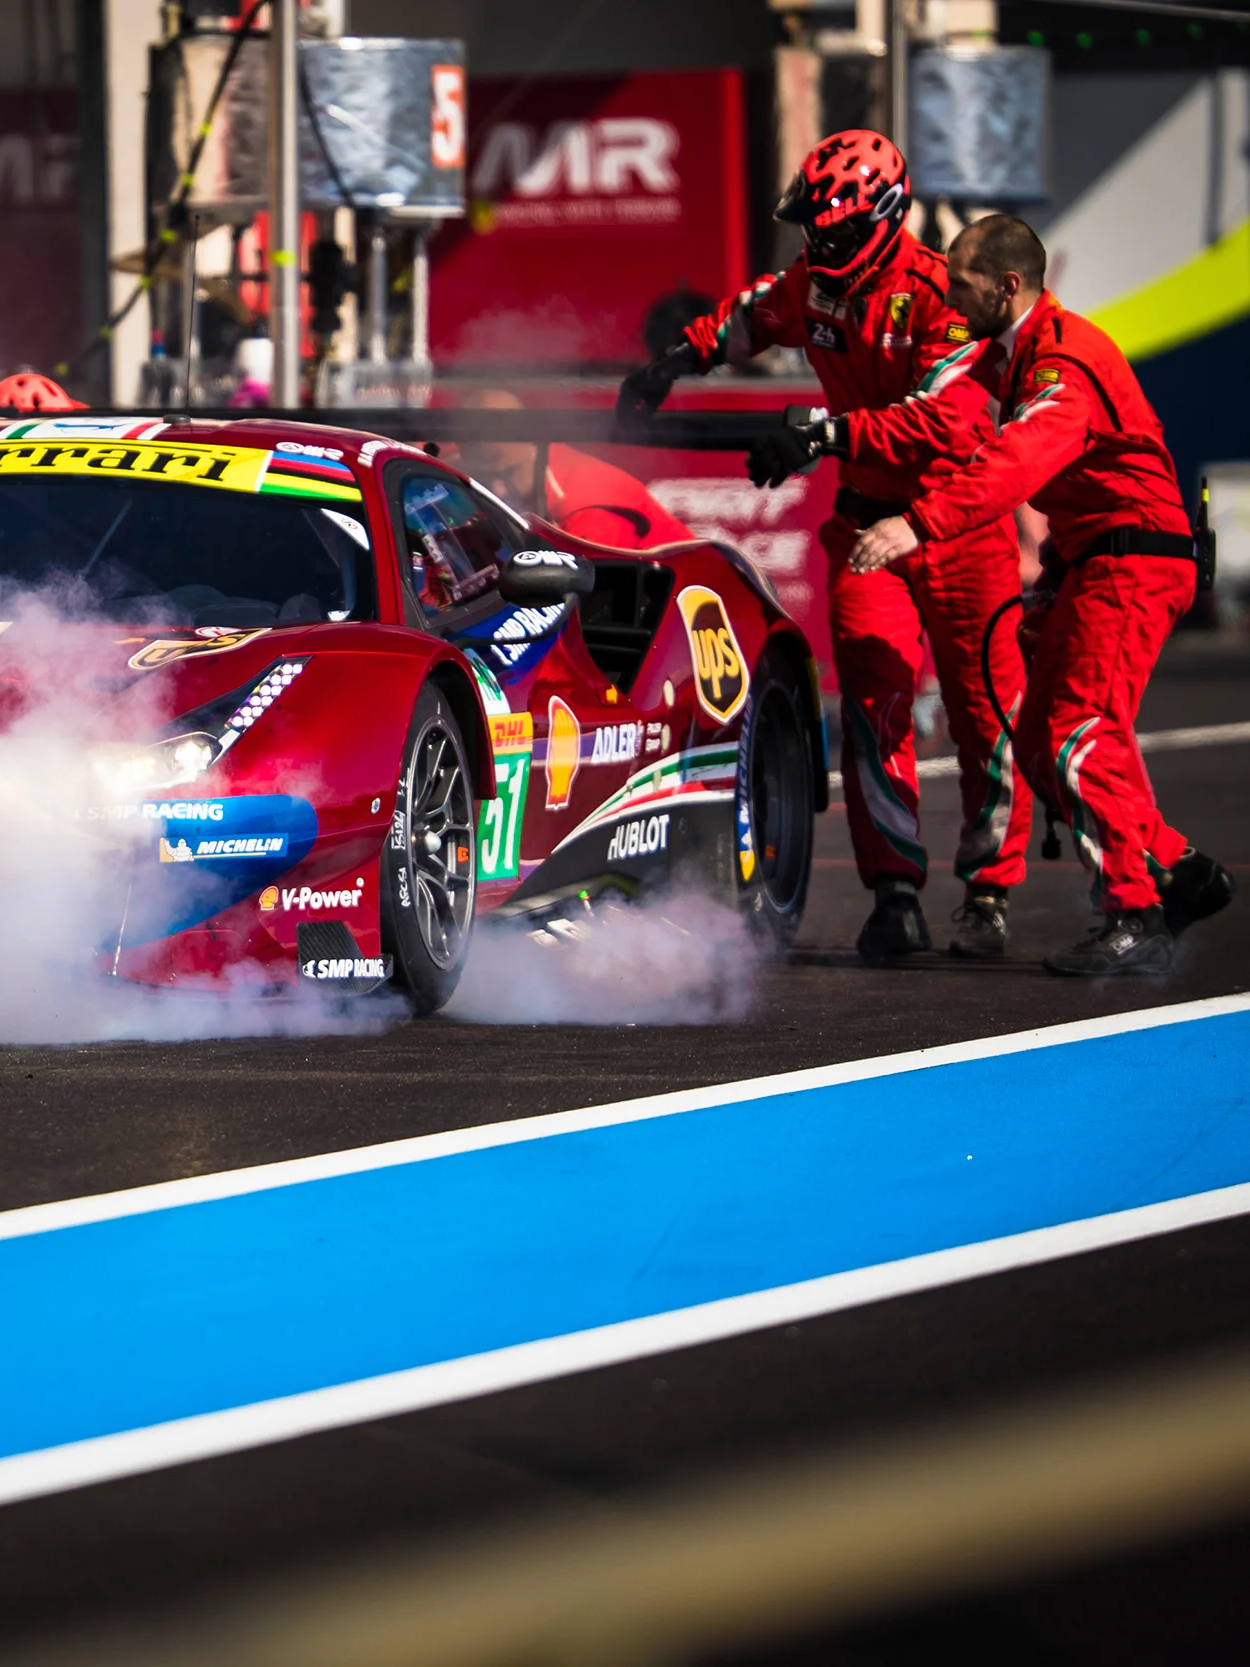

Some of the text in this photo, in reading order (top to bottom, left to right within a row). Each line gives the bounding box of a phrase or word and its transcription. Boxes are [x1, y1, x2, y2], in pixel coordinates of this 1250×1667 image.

[472, 119, 680, 196] MR
[692, 627, 740, 699] ups
[493, 720, 528, 748] DHL
[590, 722, 637, 765] ADLER
[142, 803, 224, 821] RACING
[481, 757, 525, 874] 51
[197, 837, 284, 855] MICHELIN
[607, 814, 670, 861] HUBLOT
[281, 886, 362, 911] V-Power
[317, 957, 386, 979] SMP RACING
